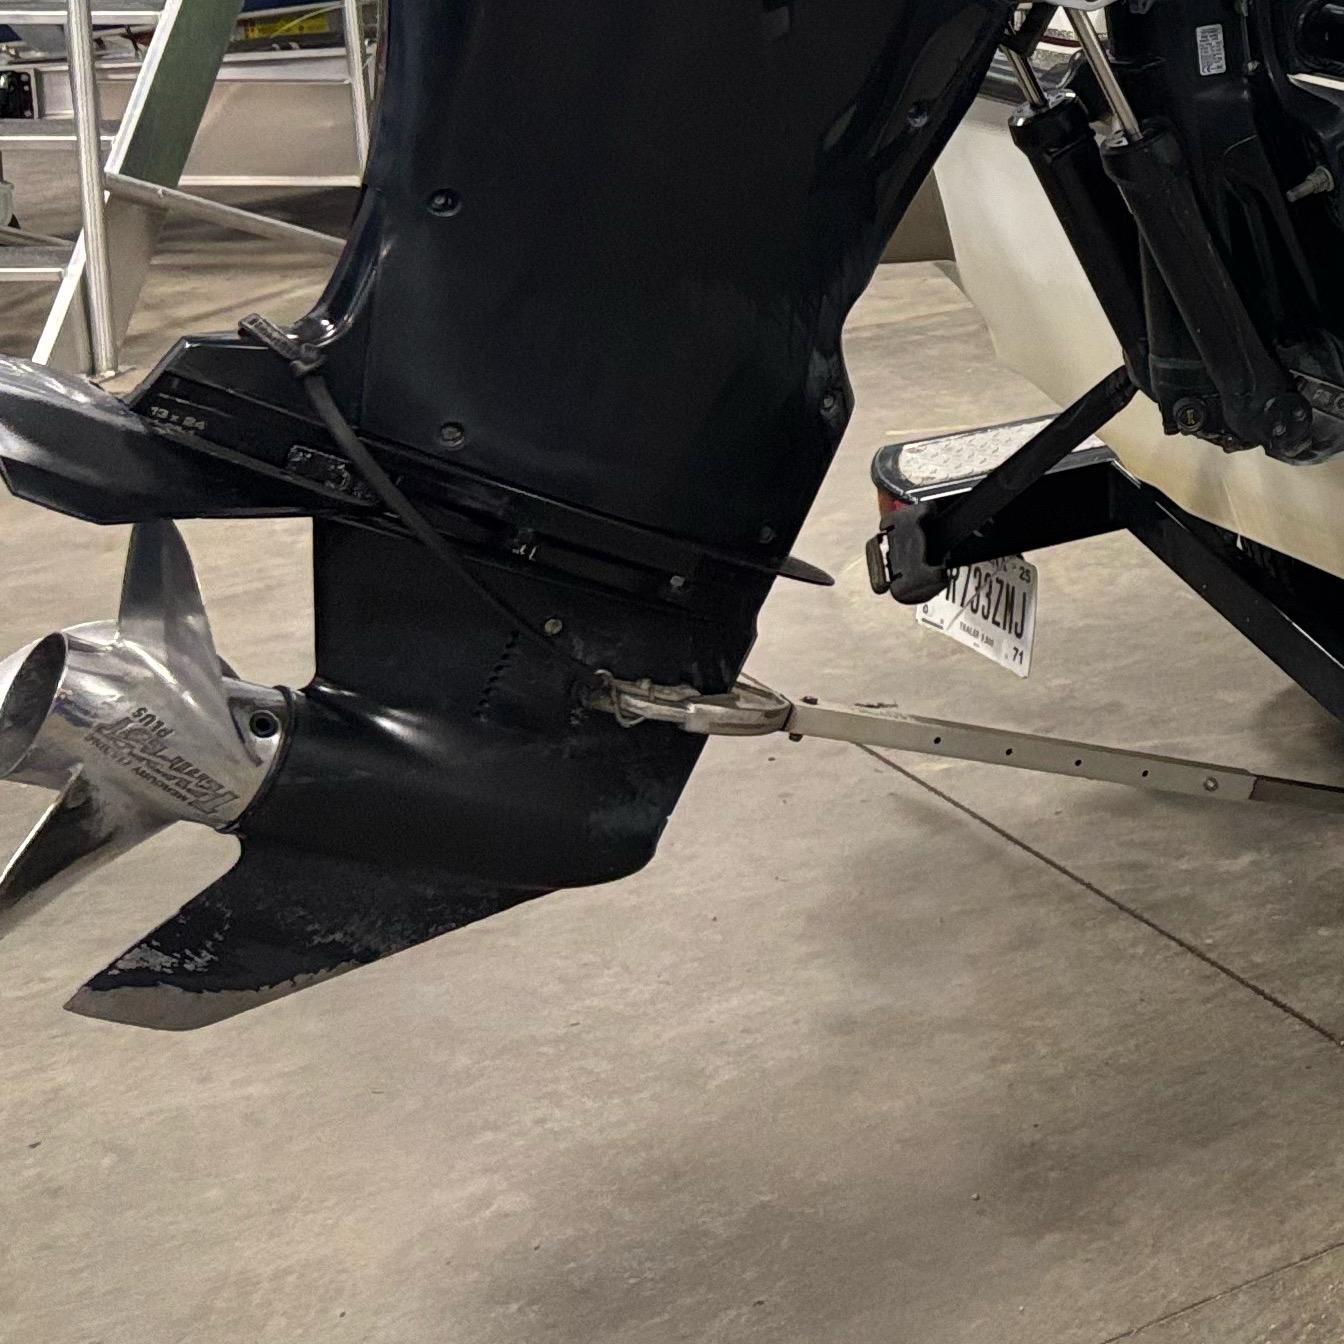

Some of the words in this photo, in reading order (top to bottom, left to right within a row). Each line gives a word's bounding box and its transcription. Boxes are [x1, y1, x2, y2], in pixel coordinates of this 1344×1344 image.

[1018, 566, 1031, 583] 25
[1013, 646, 1024, 665] 71
[132, 706, 175, 738] PLUS
